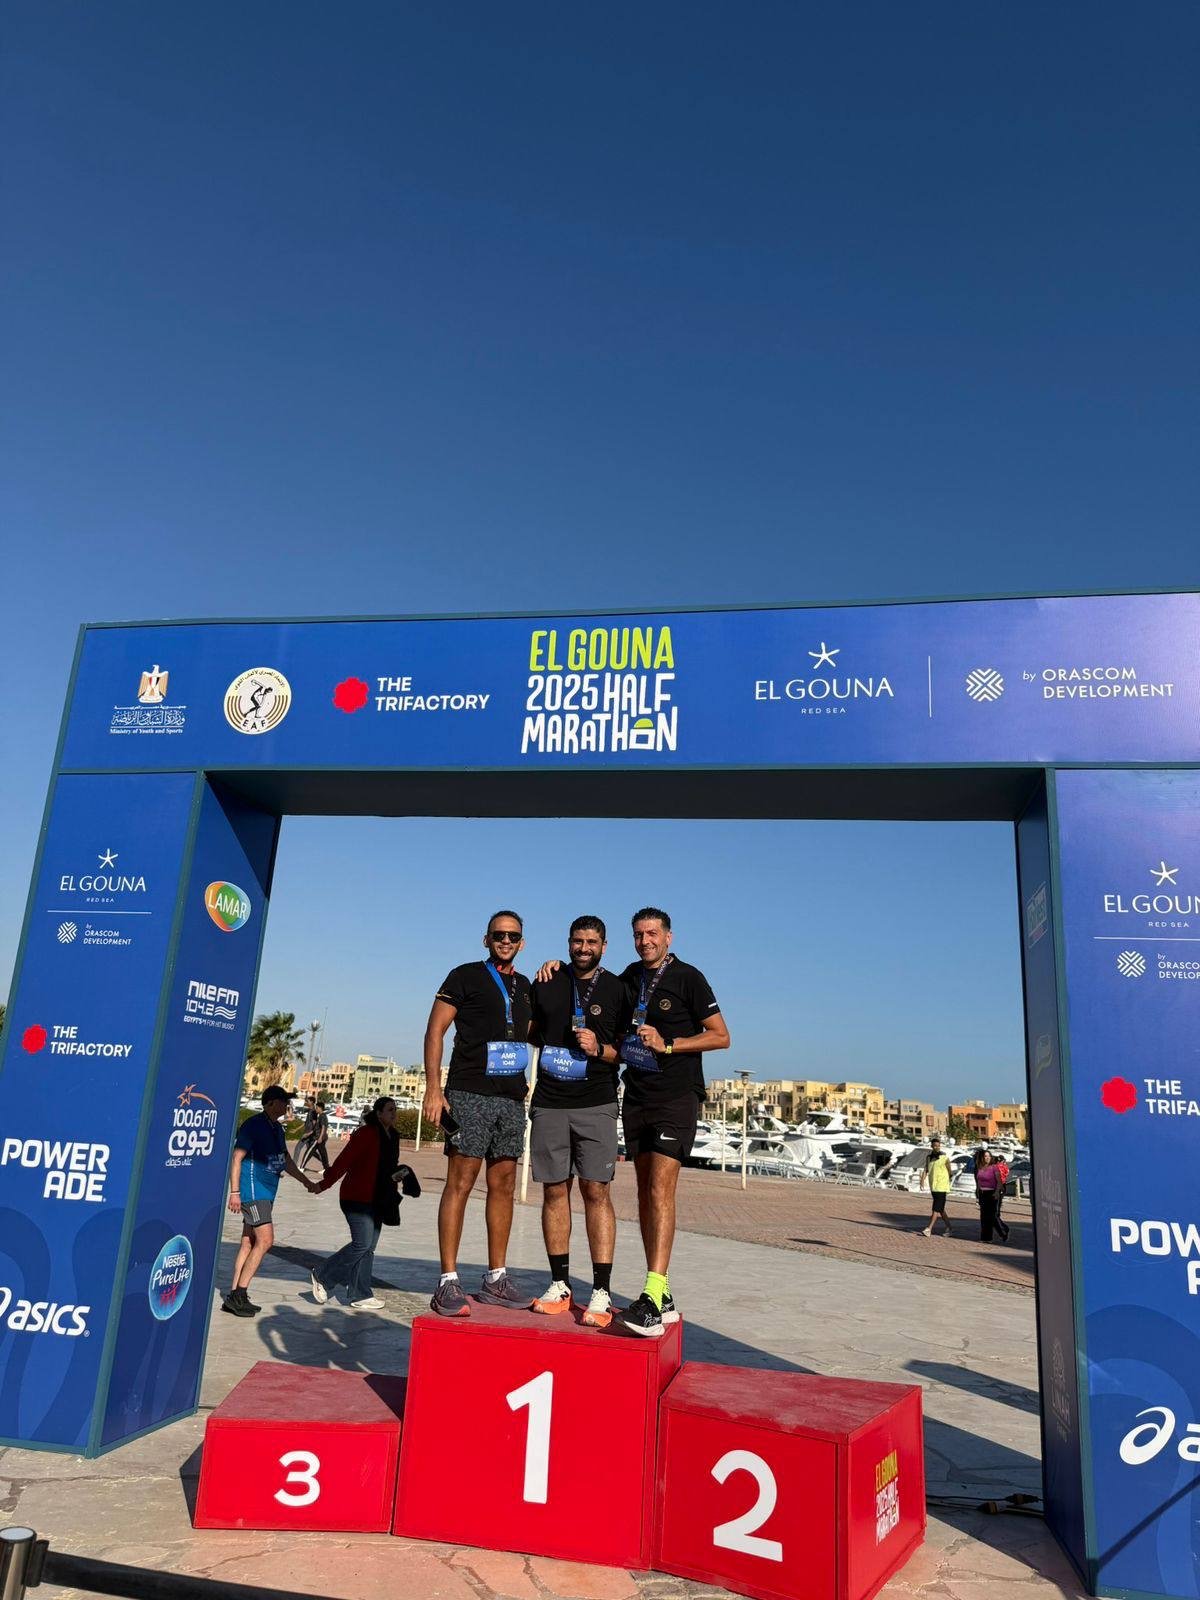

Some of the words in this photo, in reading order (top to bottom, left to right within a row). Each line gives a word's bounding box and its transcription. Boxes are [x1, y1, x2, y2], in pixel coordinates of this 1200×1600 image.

[529, 629, 563, 672] EL
[567, 625, 675, 671] GOUNA
[1022, 670, 1037, 682] by
[1042, 667, 1137, 682] ORASCOM
[378, 676, 412, 692] THE
[755, 680, 781, 701] EL
[785, 677, 895, 700] GOUNA
[1043, 683, 1175, 699] DEVELOPMENT
[375, 694, 490, 712] TRIFACTORY
[526, 673, 600, 712] 2025
[603, 672, 676, 718] HALF
[243, 719, 266, 730] EAF
[60, 876, 76, 891] EL
[80, 876, 146, 892] GOUNA
[209, 889, 248, 920] LAMAR
[1104, 895, 1129, 913] EL
[186, 998, 215, 1016] 104.2
[53, 1025, 78, 1039] THE
[50, 1041, 133, 1058] TRIFACTORY
[501, 1052, 517, 1060] AMR
[553, 1057, 574, 1067] HANY
[1144, 1078, 1182, 1095] THE
[168, 1128, 216, 1157] نجوم
[1, 1137, 110, 1173] POWER
[506, 1371, 554, 1505] 1
[273, 1450, 321, 1507] 3
[711, 1449, 784, 1563] 2
